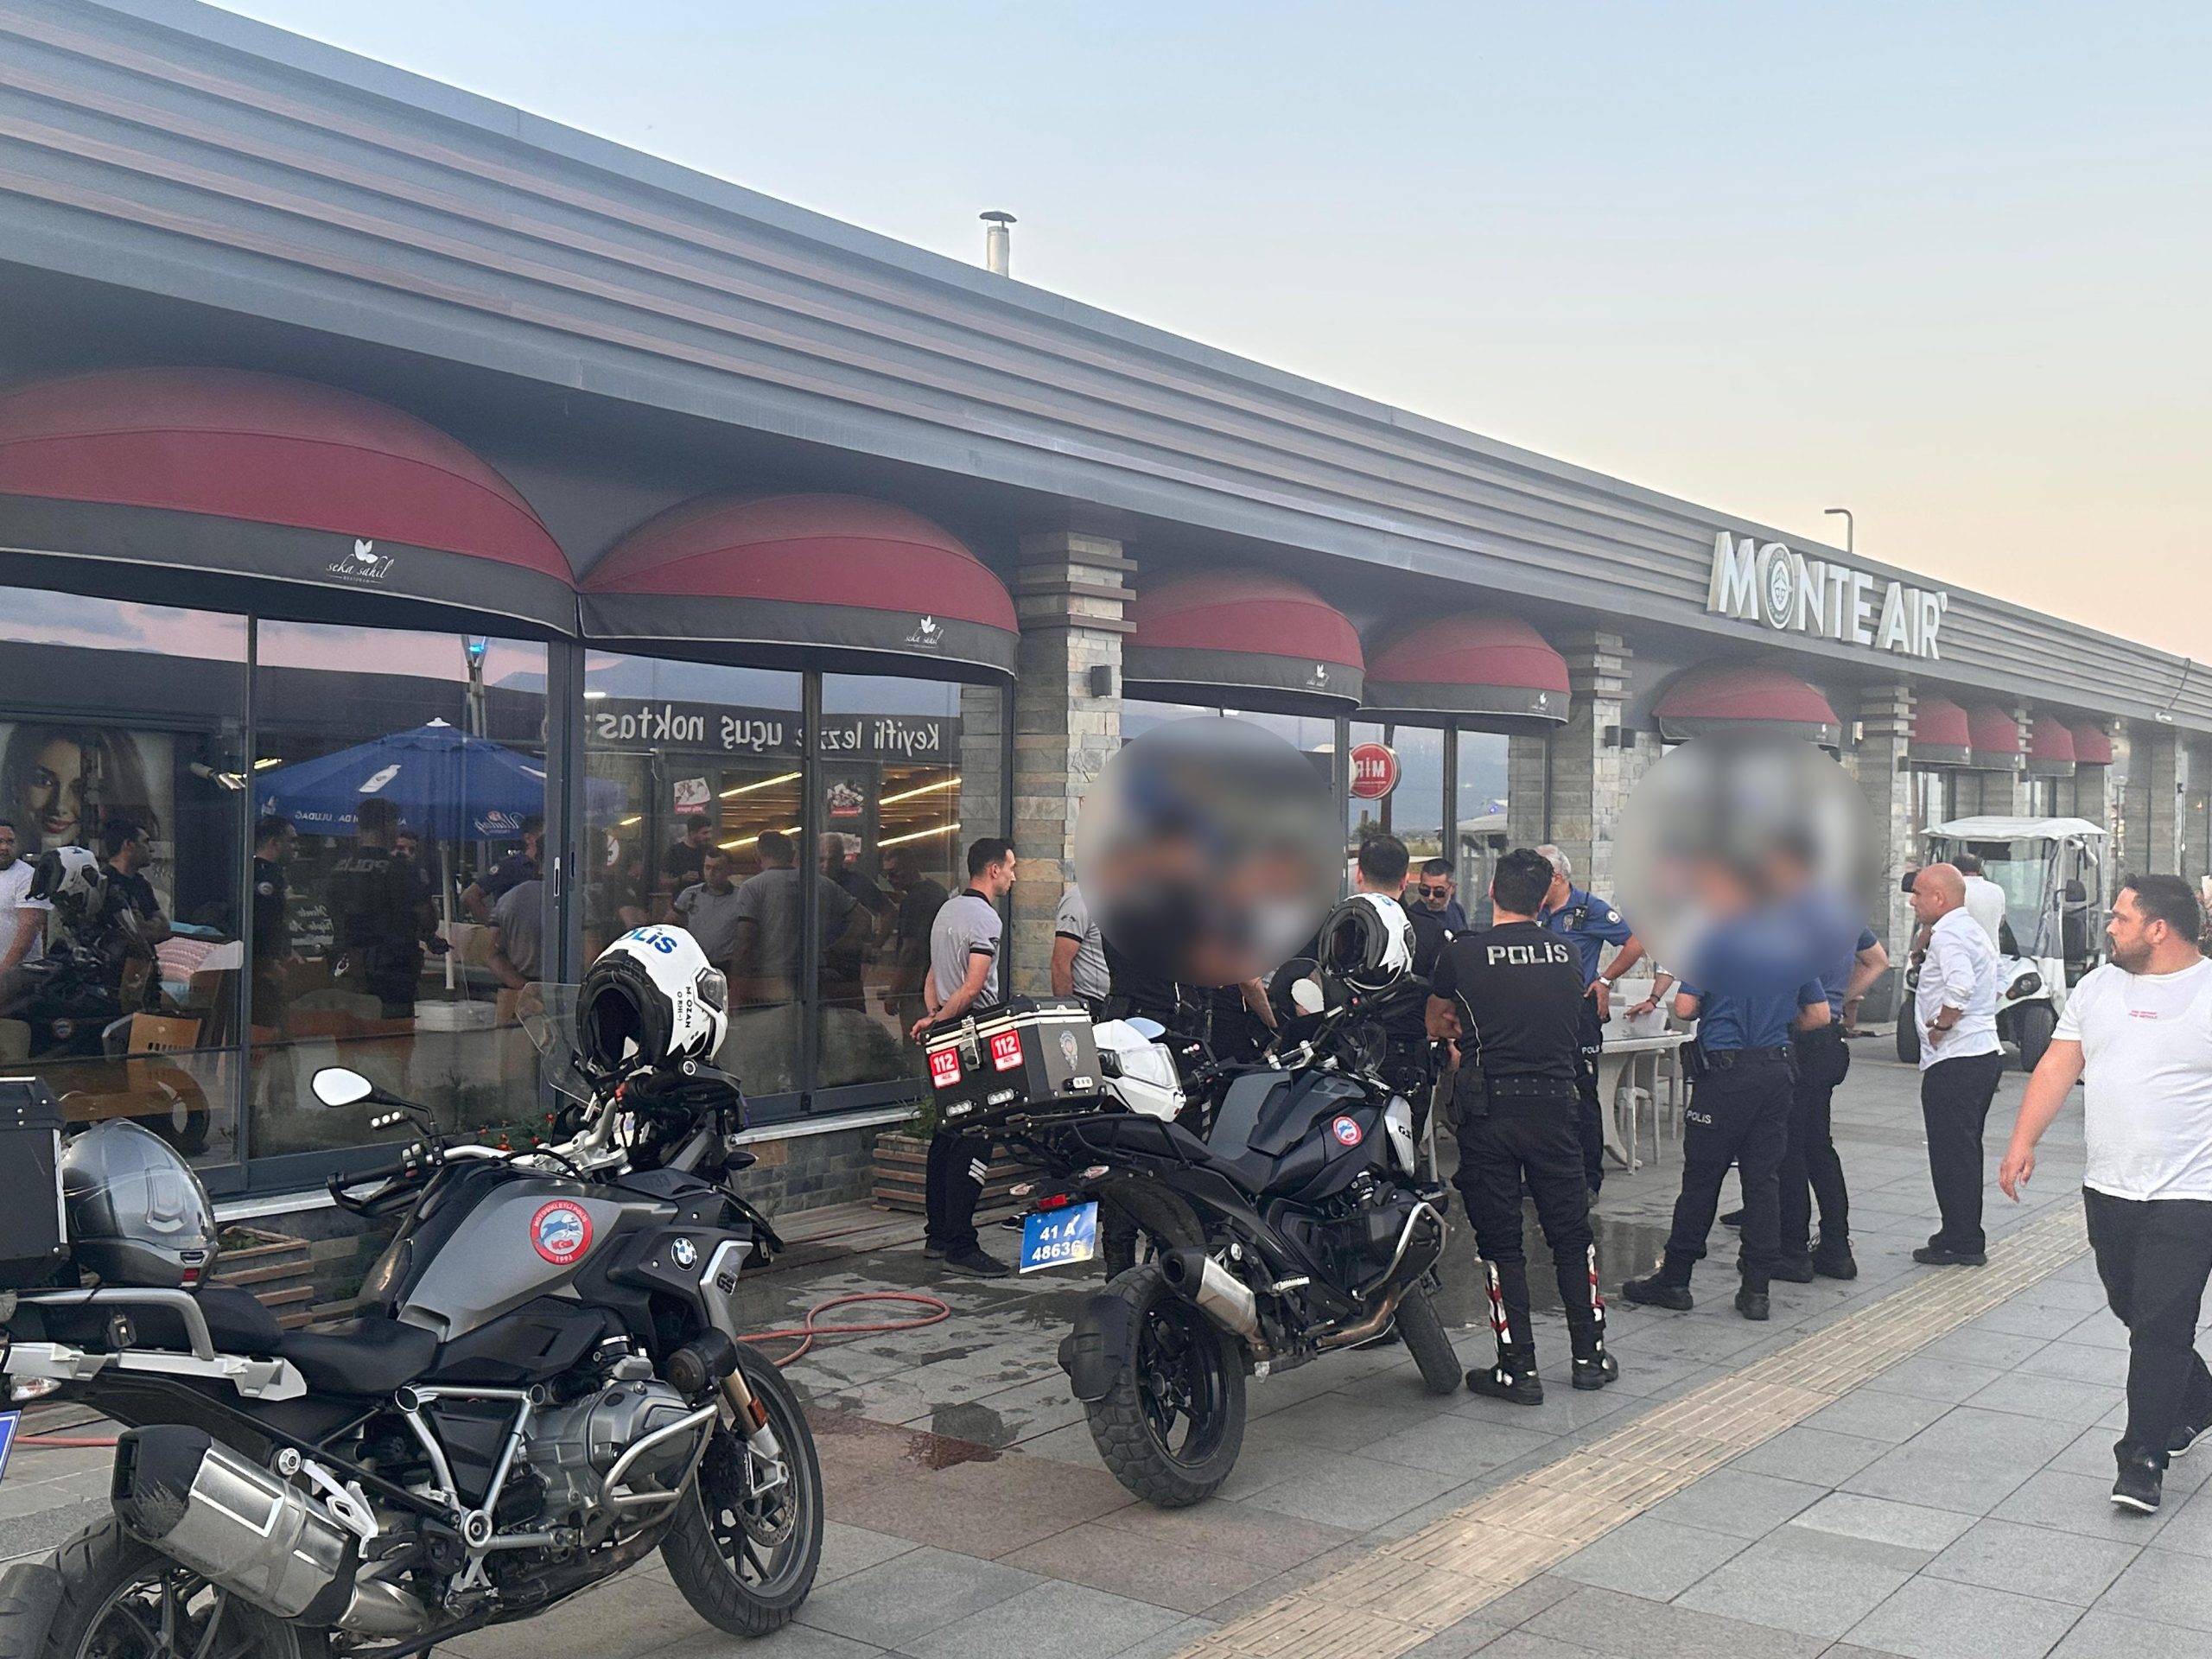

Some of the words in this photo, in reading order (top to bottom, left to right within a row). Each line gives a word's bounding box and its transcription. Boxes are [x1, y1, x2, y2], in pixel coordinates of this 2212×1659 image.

[326, 554, 355, 575] seka
[1707, 530, 1873, 646] MONTE
[1486, 941, 1570, 966] POLİS
[994, 1038, 1018, 1057] 112
[933, 1053, 956, 1073] 112
[1039, 1224, 1058, 1241] 41
